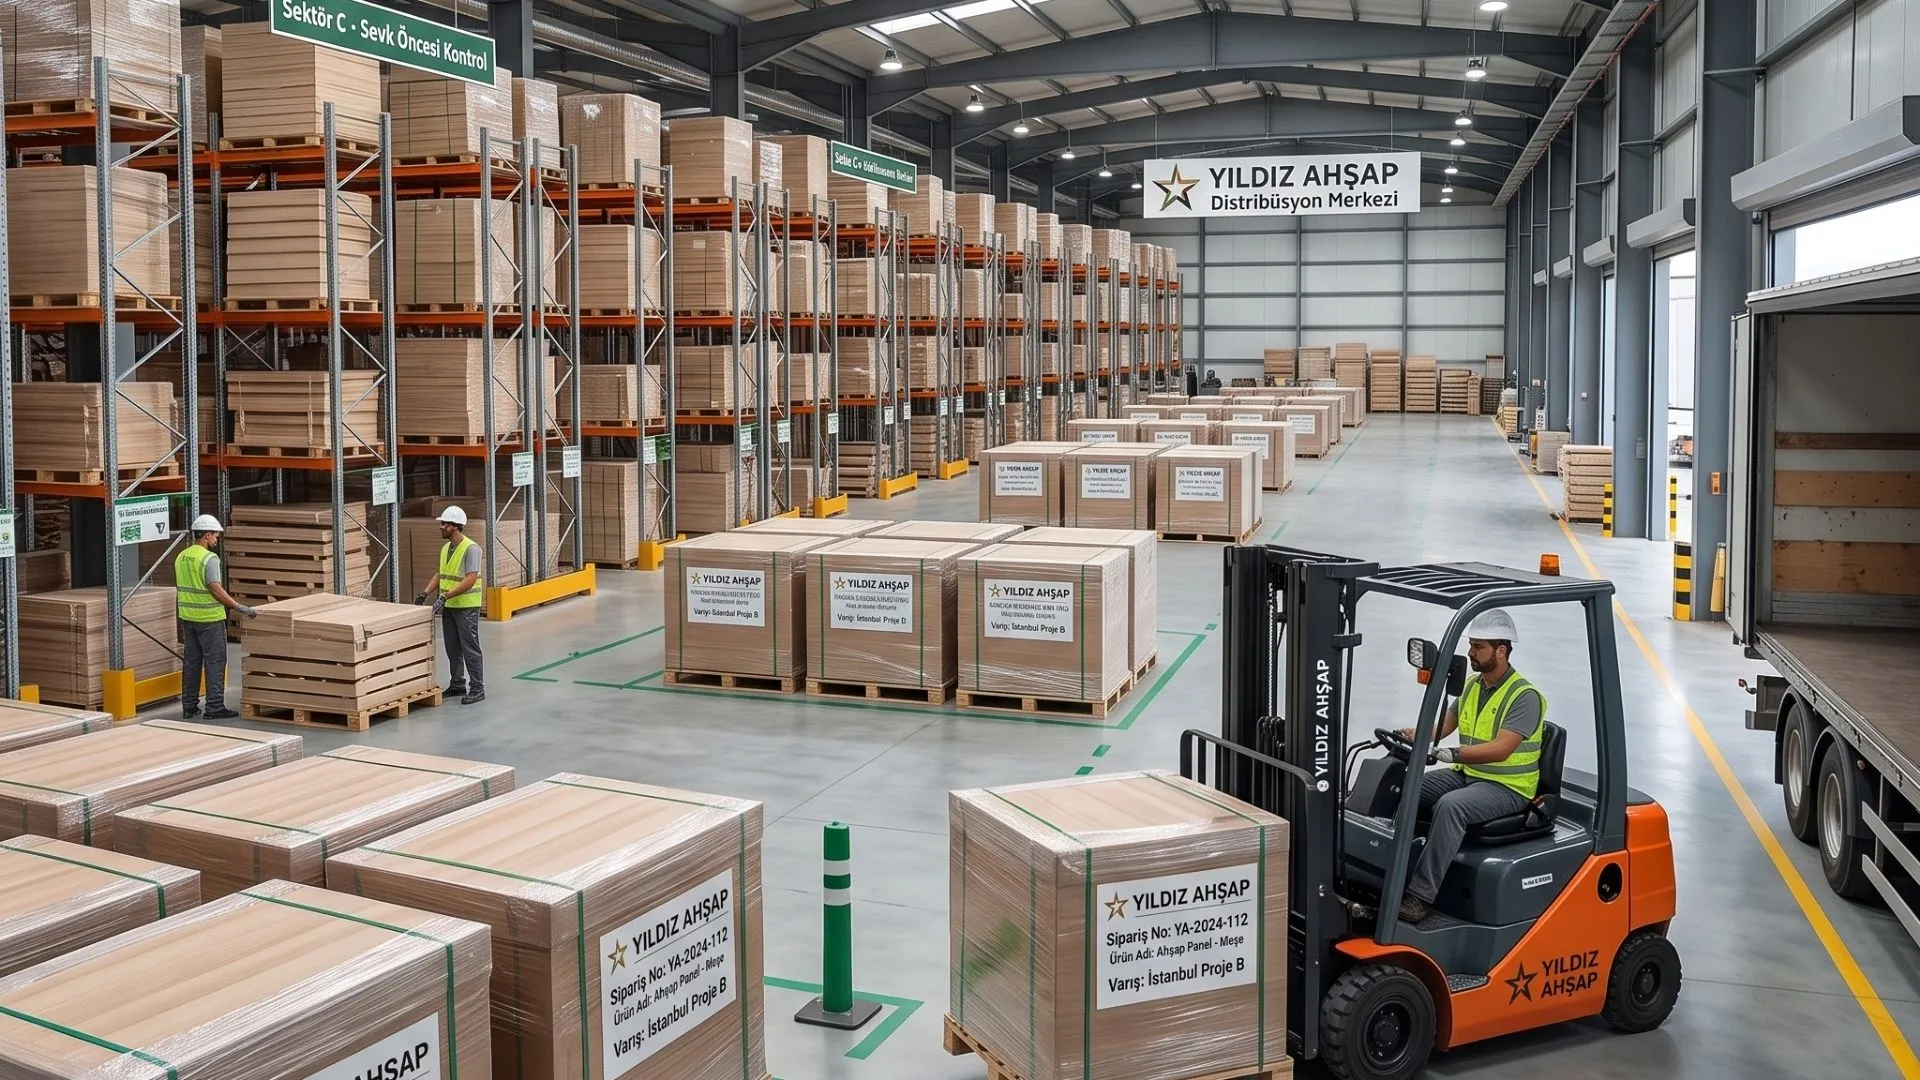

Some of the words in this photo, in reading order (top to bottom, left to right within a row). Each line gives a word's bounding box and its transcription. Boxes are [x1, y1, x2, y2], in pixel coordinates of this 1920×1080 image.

[283, 0, 333, 29] Sektör
[337, 13, 346, 33] C
[360, 19, 394, 46] Sevk
[398, 24, 440, 58] Öncesi
[444, 42, 487, 71] Kontrol
[1209, 166, 1294, 188] YILDIZ
[1303, 162, 1398, 190] AHŞAP
[1212, 193, 1322, 214] Distribüsyon
[1328, 191, 1398, 208] Merkezi
[703, 574, 730, 584] YILDIZ
[732, 576, 761, 588] AHŞAP
[848, 579, 876, 588] YILDIZ
[878, 580, 909, 592] AHŞAP
[1003, 586, 1034, 596] YILDIZ
[1036, 588, 1070, 600] AHŞAP
[1316, 659, 1332, 719] AHŞAP
[1315, 724, 1329, 777] YILDIZ
[1133, 888, 1188, 910] YILDIZ
[1192, 879, 1250, 903] AHŞAP
[632, 914, 680, 955] YILDIZ
[683, 889, 728, 929] AHŞAP
[1106, 928, 1148, 948] Sipariş
[1152, 926, 1171, 940] No:
[1175, 913, 1248, 936] YA-2024-112
[610, 974, 646, 1005] Sipariş
[649, 964, 666, 984] No:
[668, 926, 728, 972] YA-2024-112
[1110, 951, 1134, 965] Ürün
[1136, 948, 1154, 961] Adı:
[1156, 944, 1185, 957] Ahşap
[1188, 938, 1212, 953] Panel
[1220, 935, 1244, 948] Meşe
[1542, 950, 1599, 976] YILDIZ
[1108, 975, 1145, 993] Varış:
[1148, 964, 1197, 986] İstanbul
[1202, 960, 1232, 978] Proje
[1237, 958, 1245, 970] B
[1541, 972, 1598, 998] AHŞAP
[614, 1029, 645, 1058] Varış:
[648, 998, 688, 1039] İstanbul
[692, 988, 716, 1012] Proje
[720, 977, 727, 994] B
